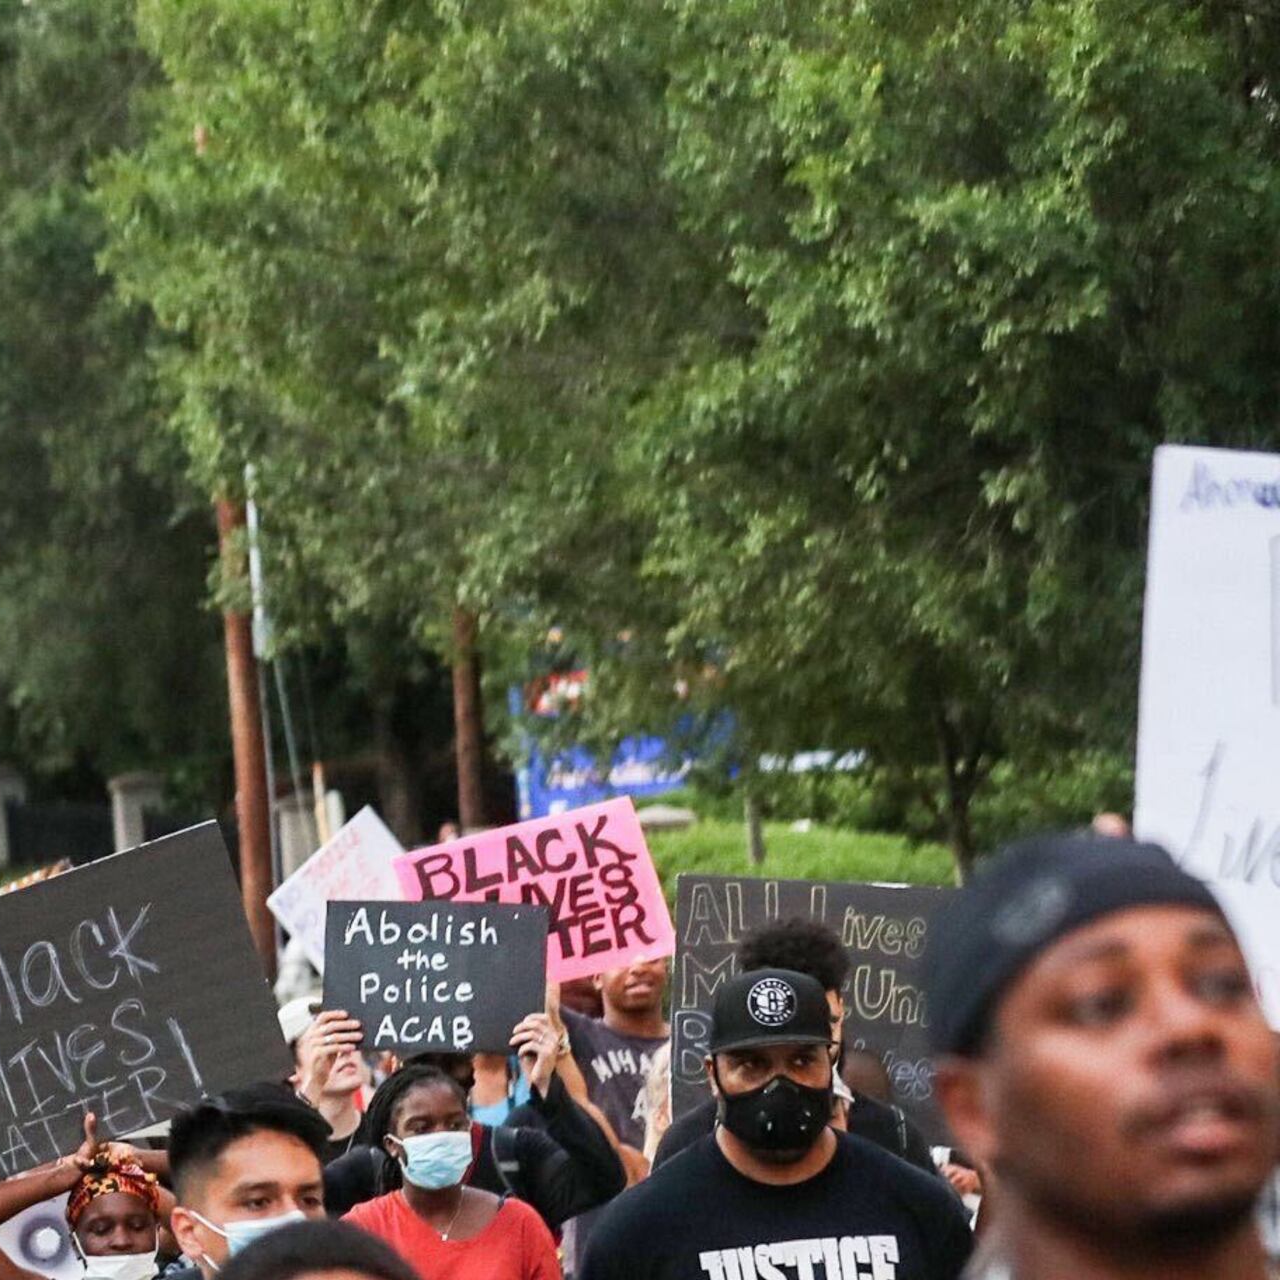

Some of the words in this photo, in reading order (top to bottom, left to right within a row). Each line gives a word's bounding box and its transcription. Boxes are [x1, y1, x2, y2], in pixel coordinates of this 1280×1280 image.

[413, 814, 637, 901] BLACK
[343, 906, 499, 946] Abolish
[547, 904, 656, 960] TER
[396, 949, 449, 971] the
[360, 972, 474, 1003] Police
[374, 1015, 474, 1050] ACAB
